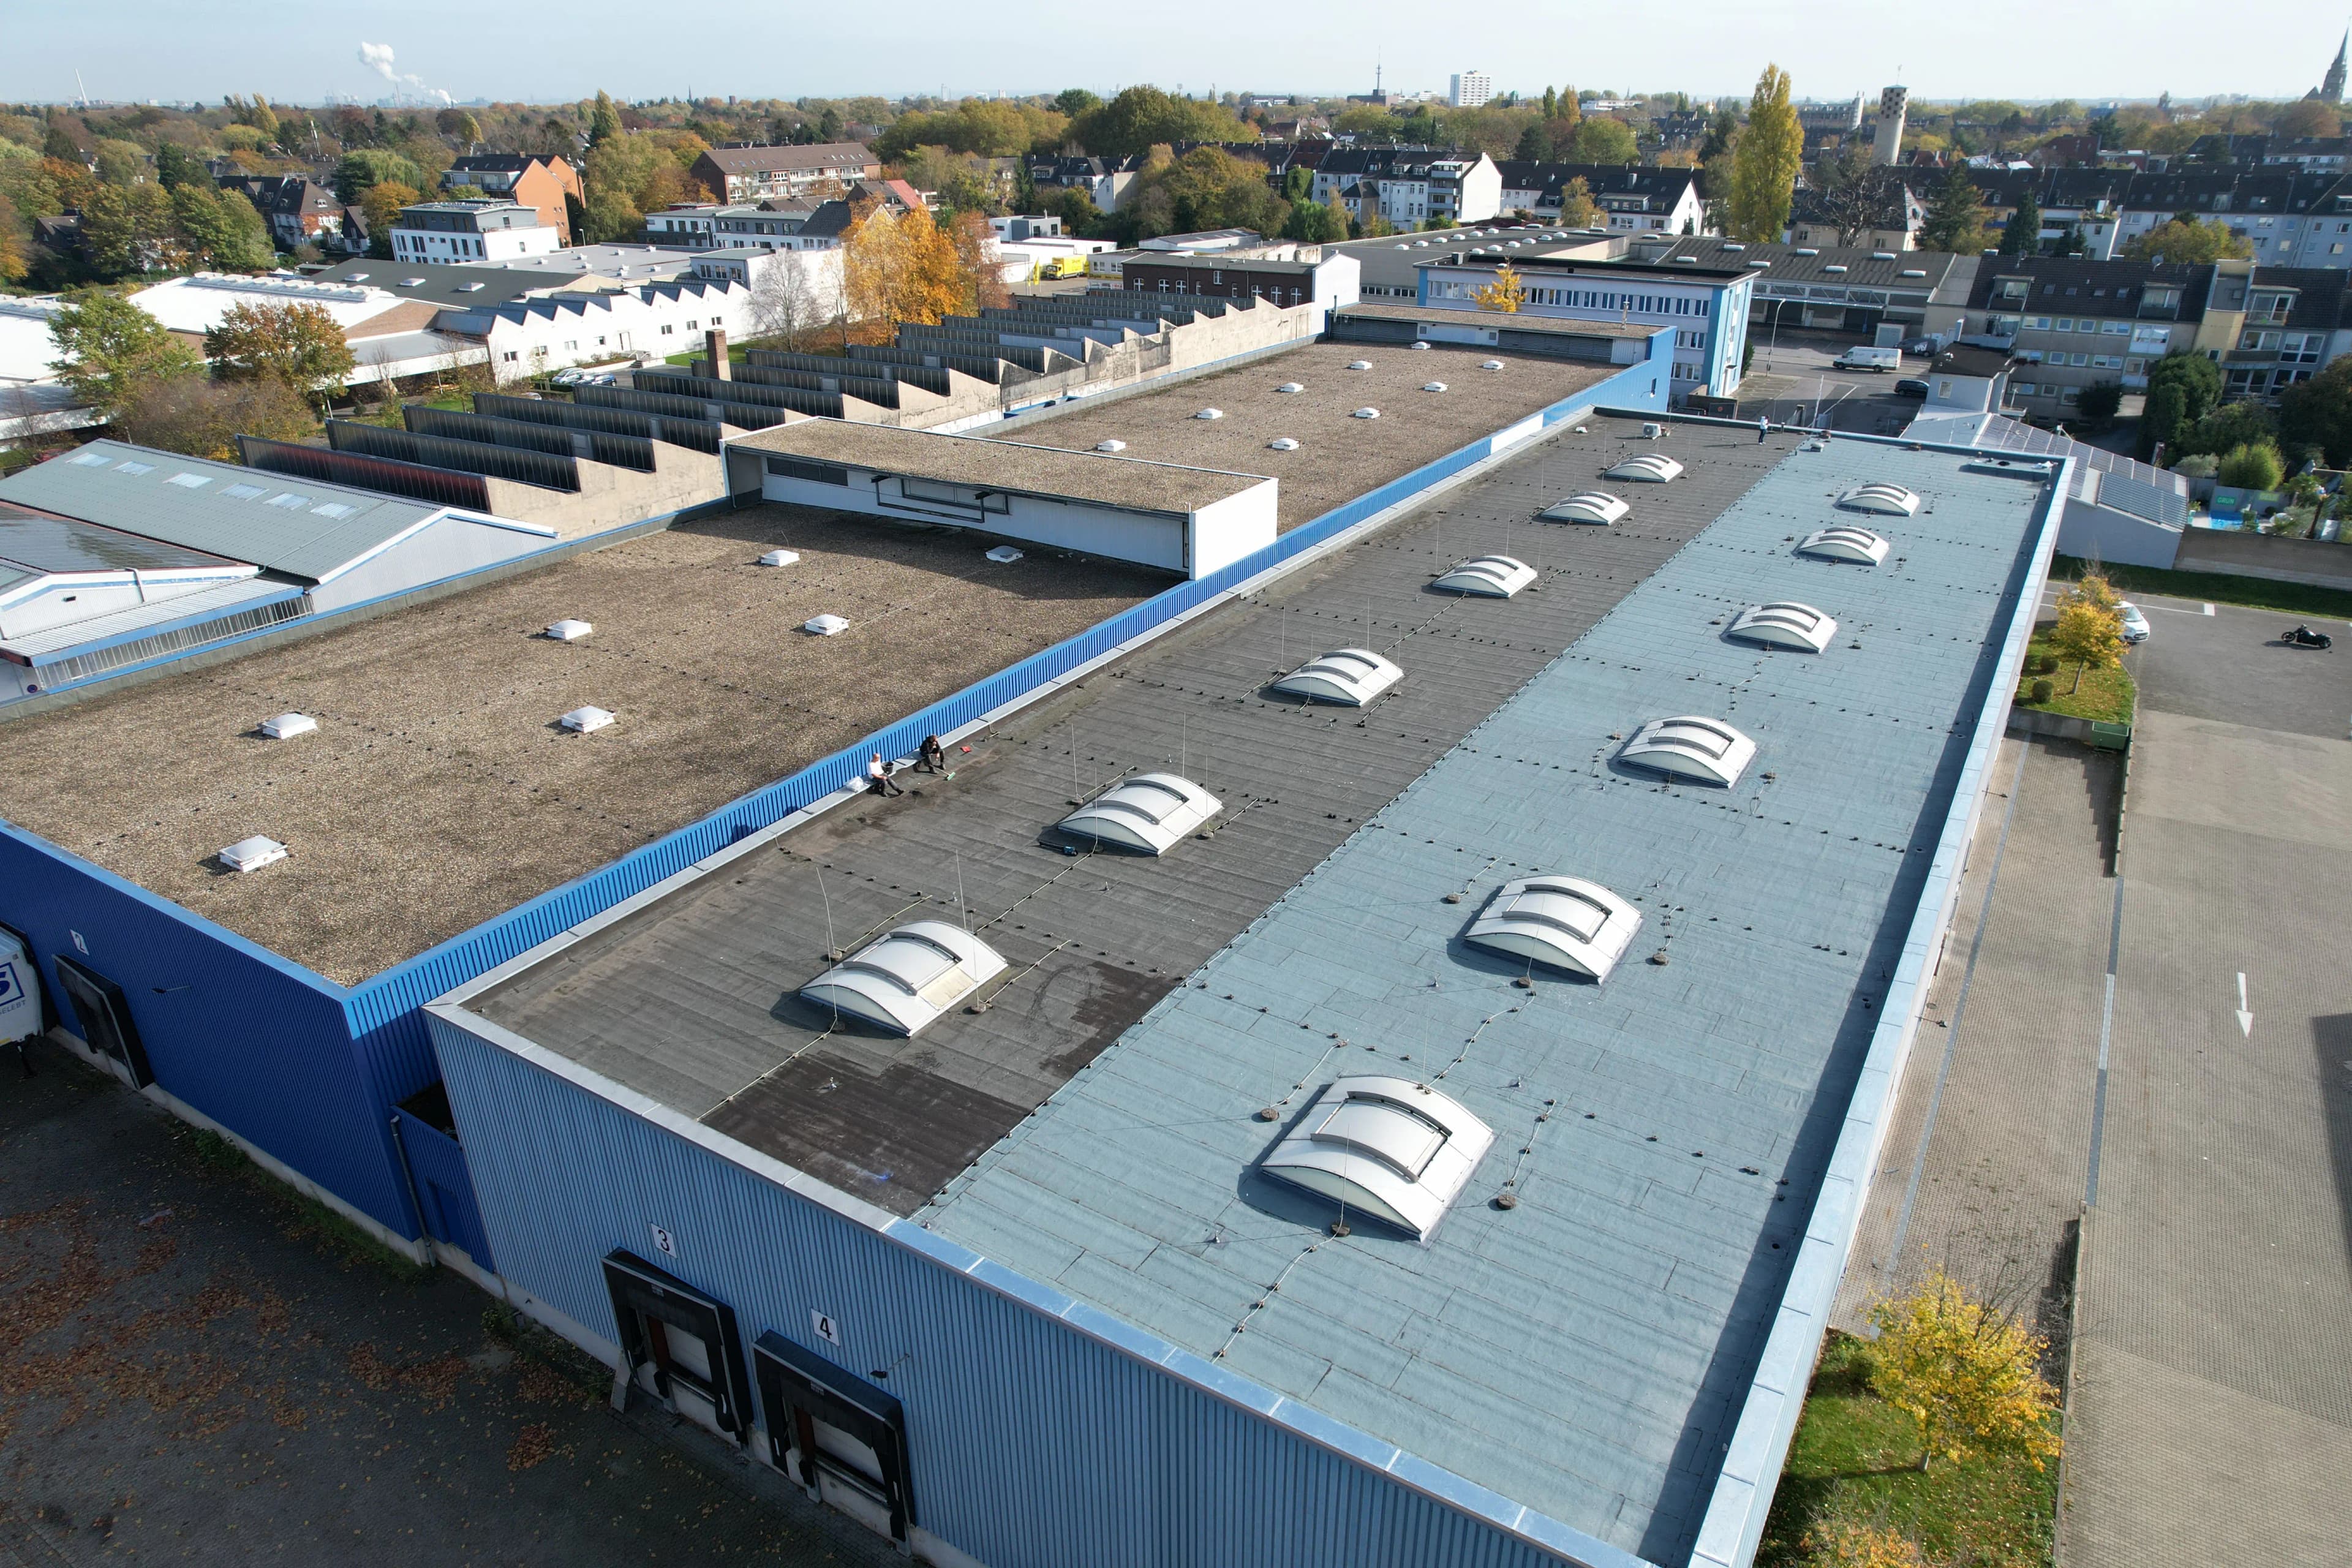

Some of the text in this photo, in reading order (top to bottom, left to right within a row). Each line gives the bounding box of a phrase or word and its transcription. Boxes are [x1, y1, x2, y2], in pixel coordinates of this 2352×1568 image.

[75, 933, 85, 952] 2
[658, 1229, 670, 1252] 3
[820, 1317, 832, 1340] 4
